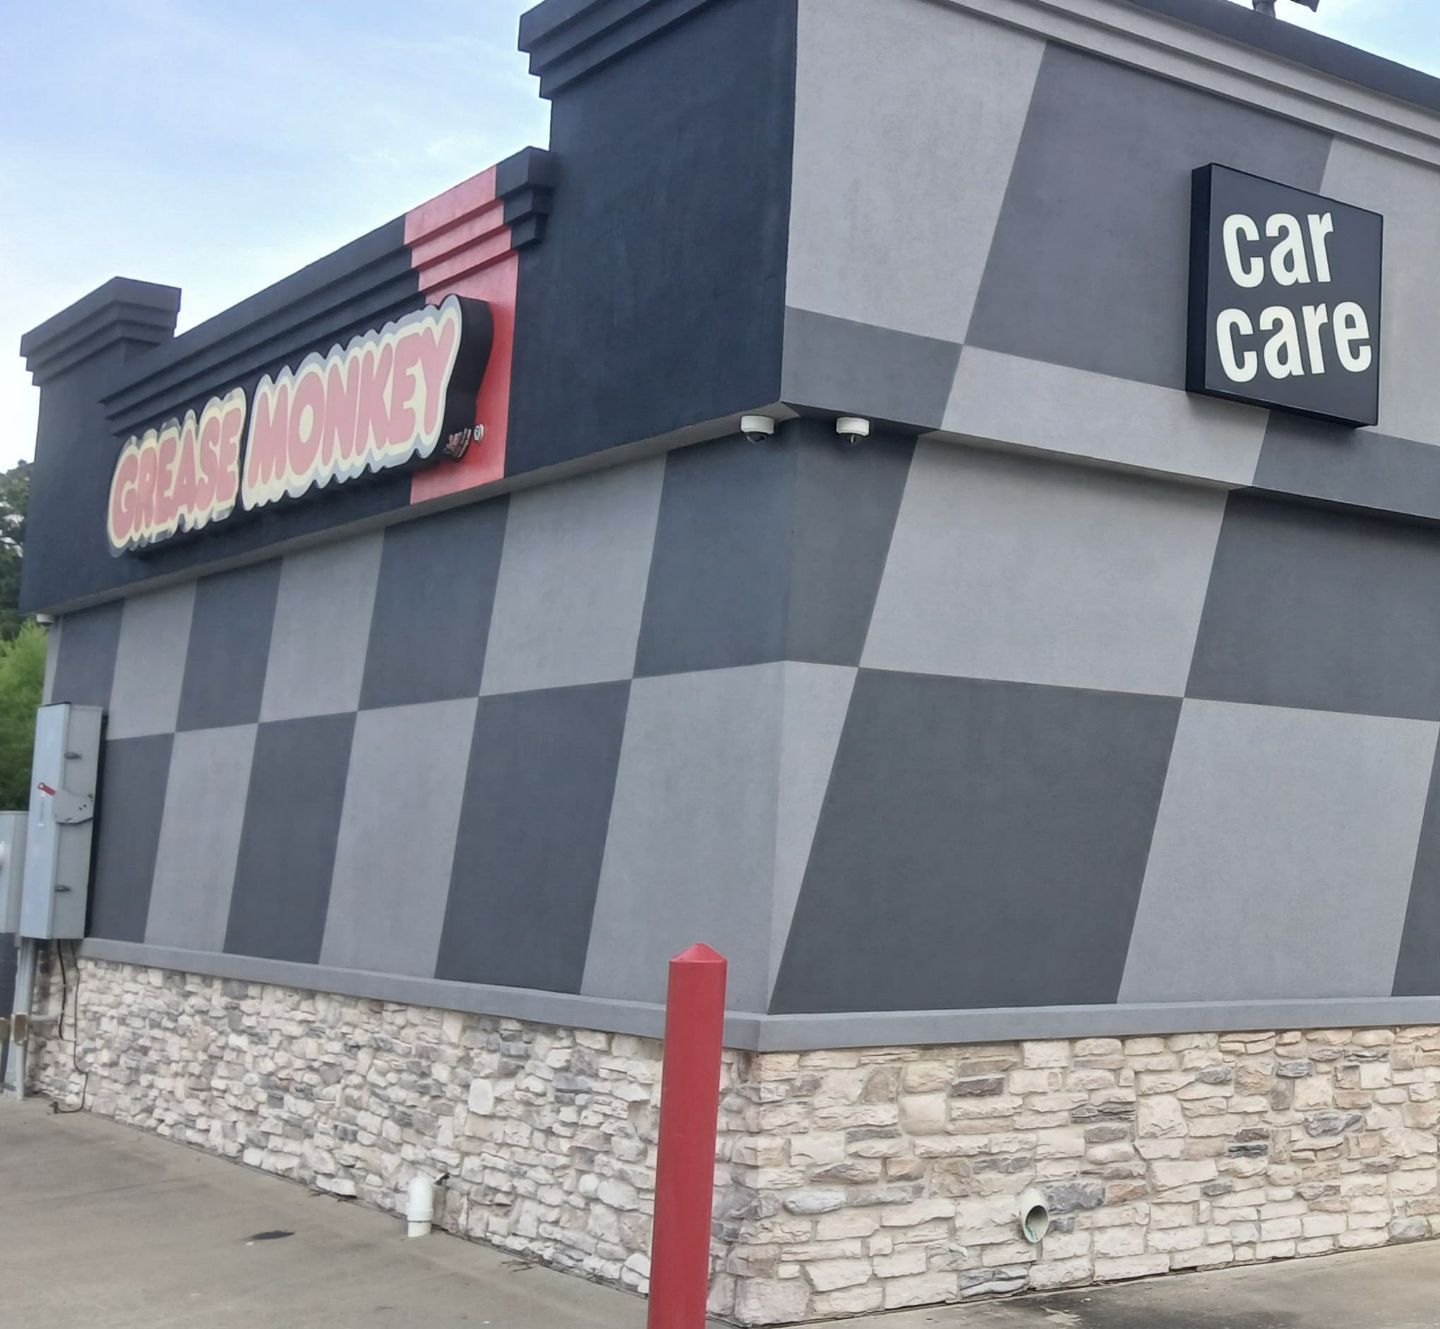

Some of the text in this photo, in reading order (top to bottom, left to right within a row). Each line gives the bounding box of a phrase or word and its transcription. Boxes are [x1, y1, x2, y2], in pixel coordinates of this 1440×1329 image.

[1222, 212, 1334, 288] car
[1216, 301, 1372, 383] care
[113, 317, 456, 541] GREASE MONKEY
